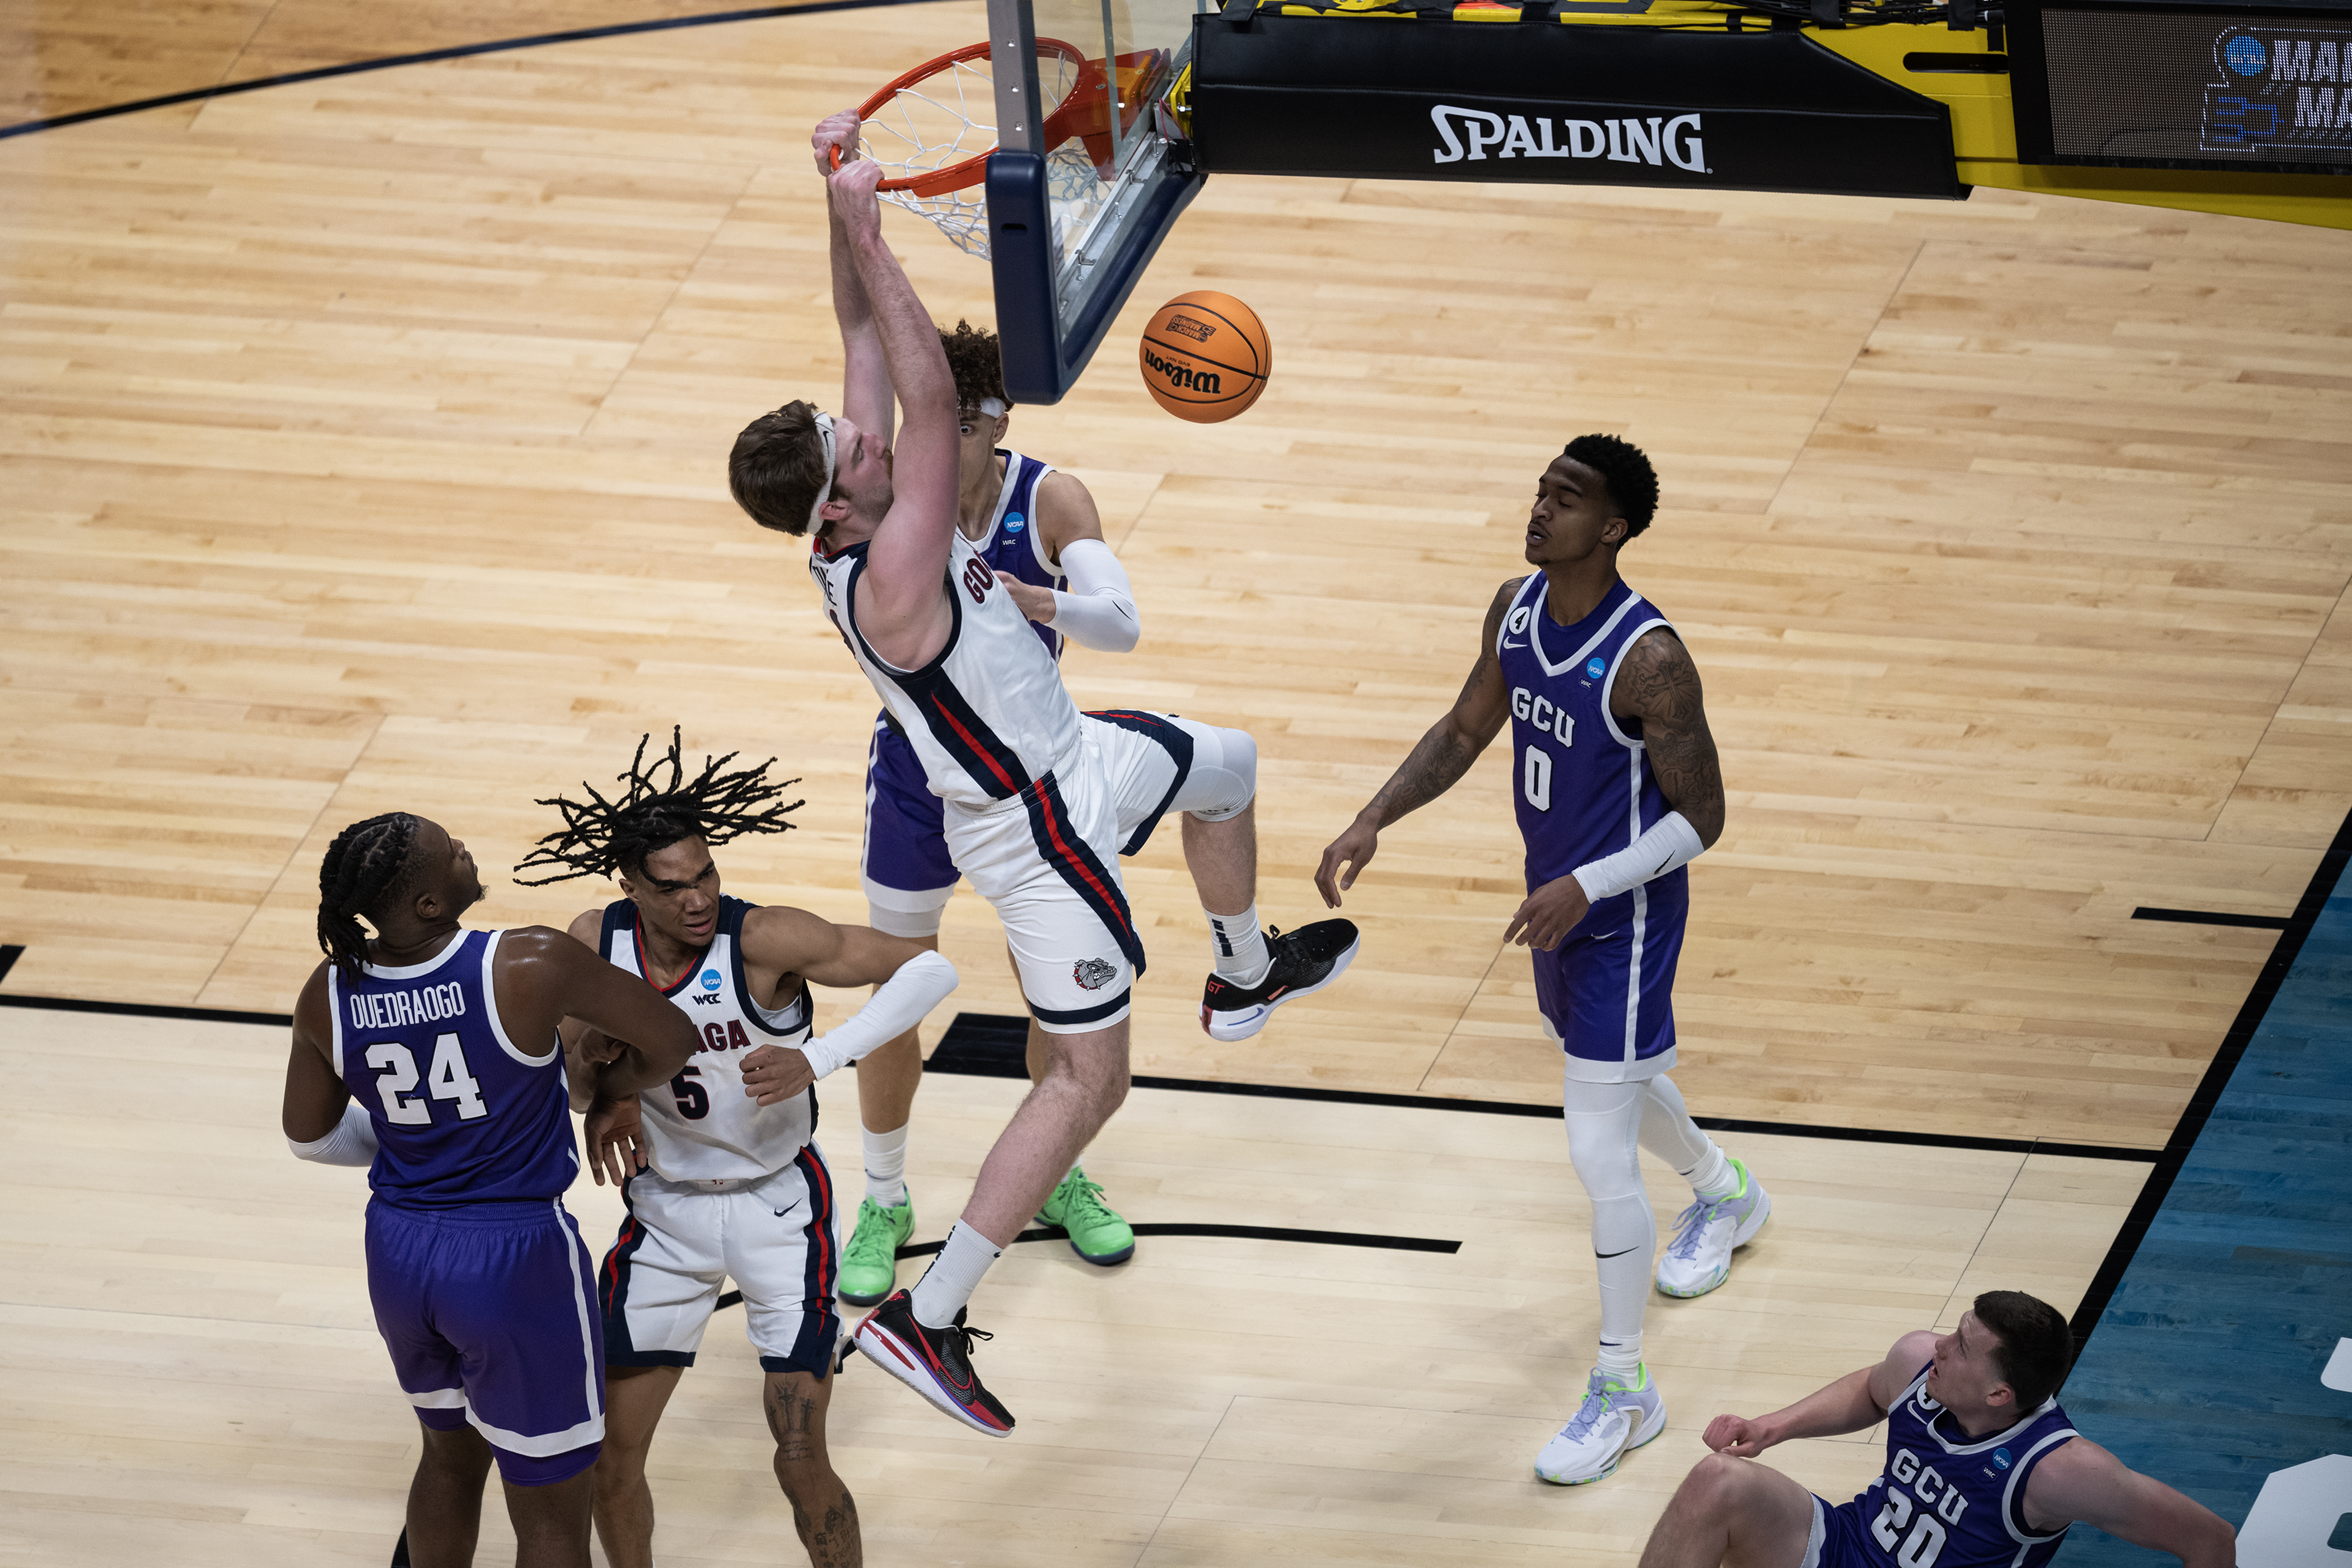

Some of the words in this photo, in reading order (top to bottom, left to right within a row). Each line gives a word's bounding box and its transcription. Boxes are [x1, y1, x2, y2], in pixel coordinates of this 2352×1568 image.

[1430, 104, 1706, 173] SPALDING
[1177, 325, 1201, 339] MARCH
[1145, 347, 1221, 394] Wilson
[1515, 611, 1527, 630] 4
[1581, 679, 1592, 688] WAC
[1588, 665, 1603, 675] NCAA
[1512, 686, 1575, 748] GCU
[1524, 744, 1552, 811] 0
[349, 981, 466, 1029] OUEDRAOGO
[692, 993, 721, 1006] WCC
[1207, 981, 1225, 994] GT
[365, 1032, 488, 1125] 24
[670, 1066, 710, 1121] 5
[1983, 1467, 1996, 1479] WAC
[1994, 1454, 2009, 1468] NCAA
[1891, 1448, 1969, 1525] GCU
[1870, 1486, 1947, 1568] 20
